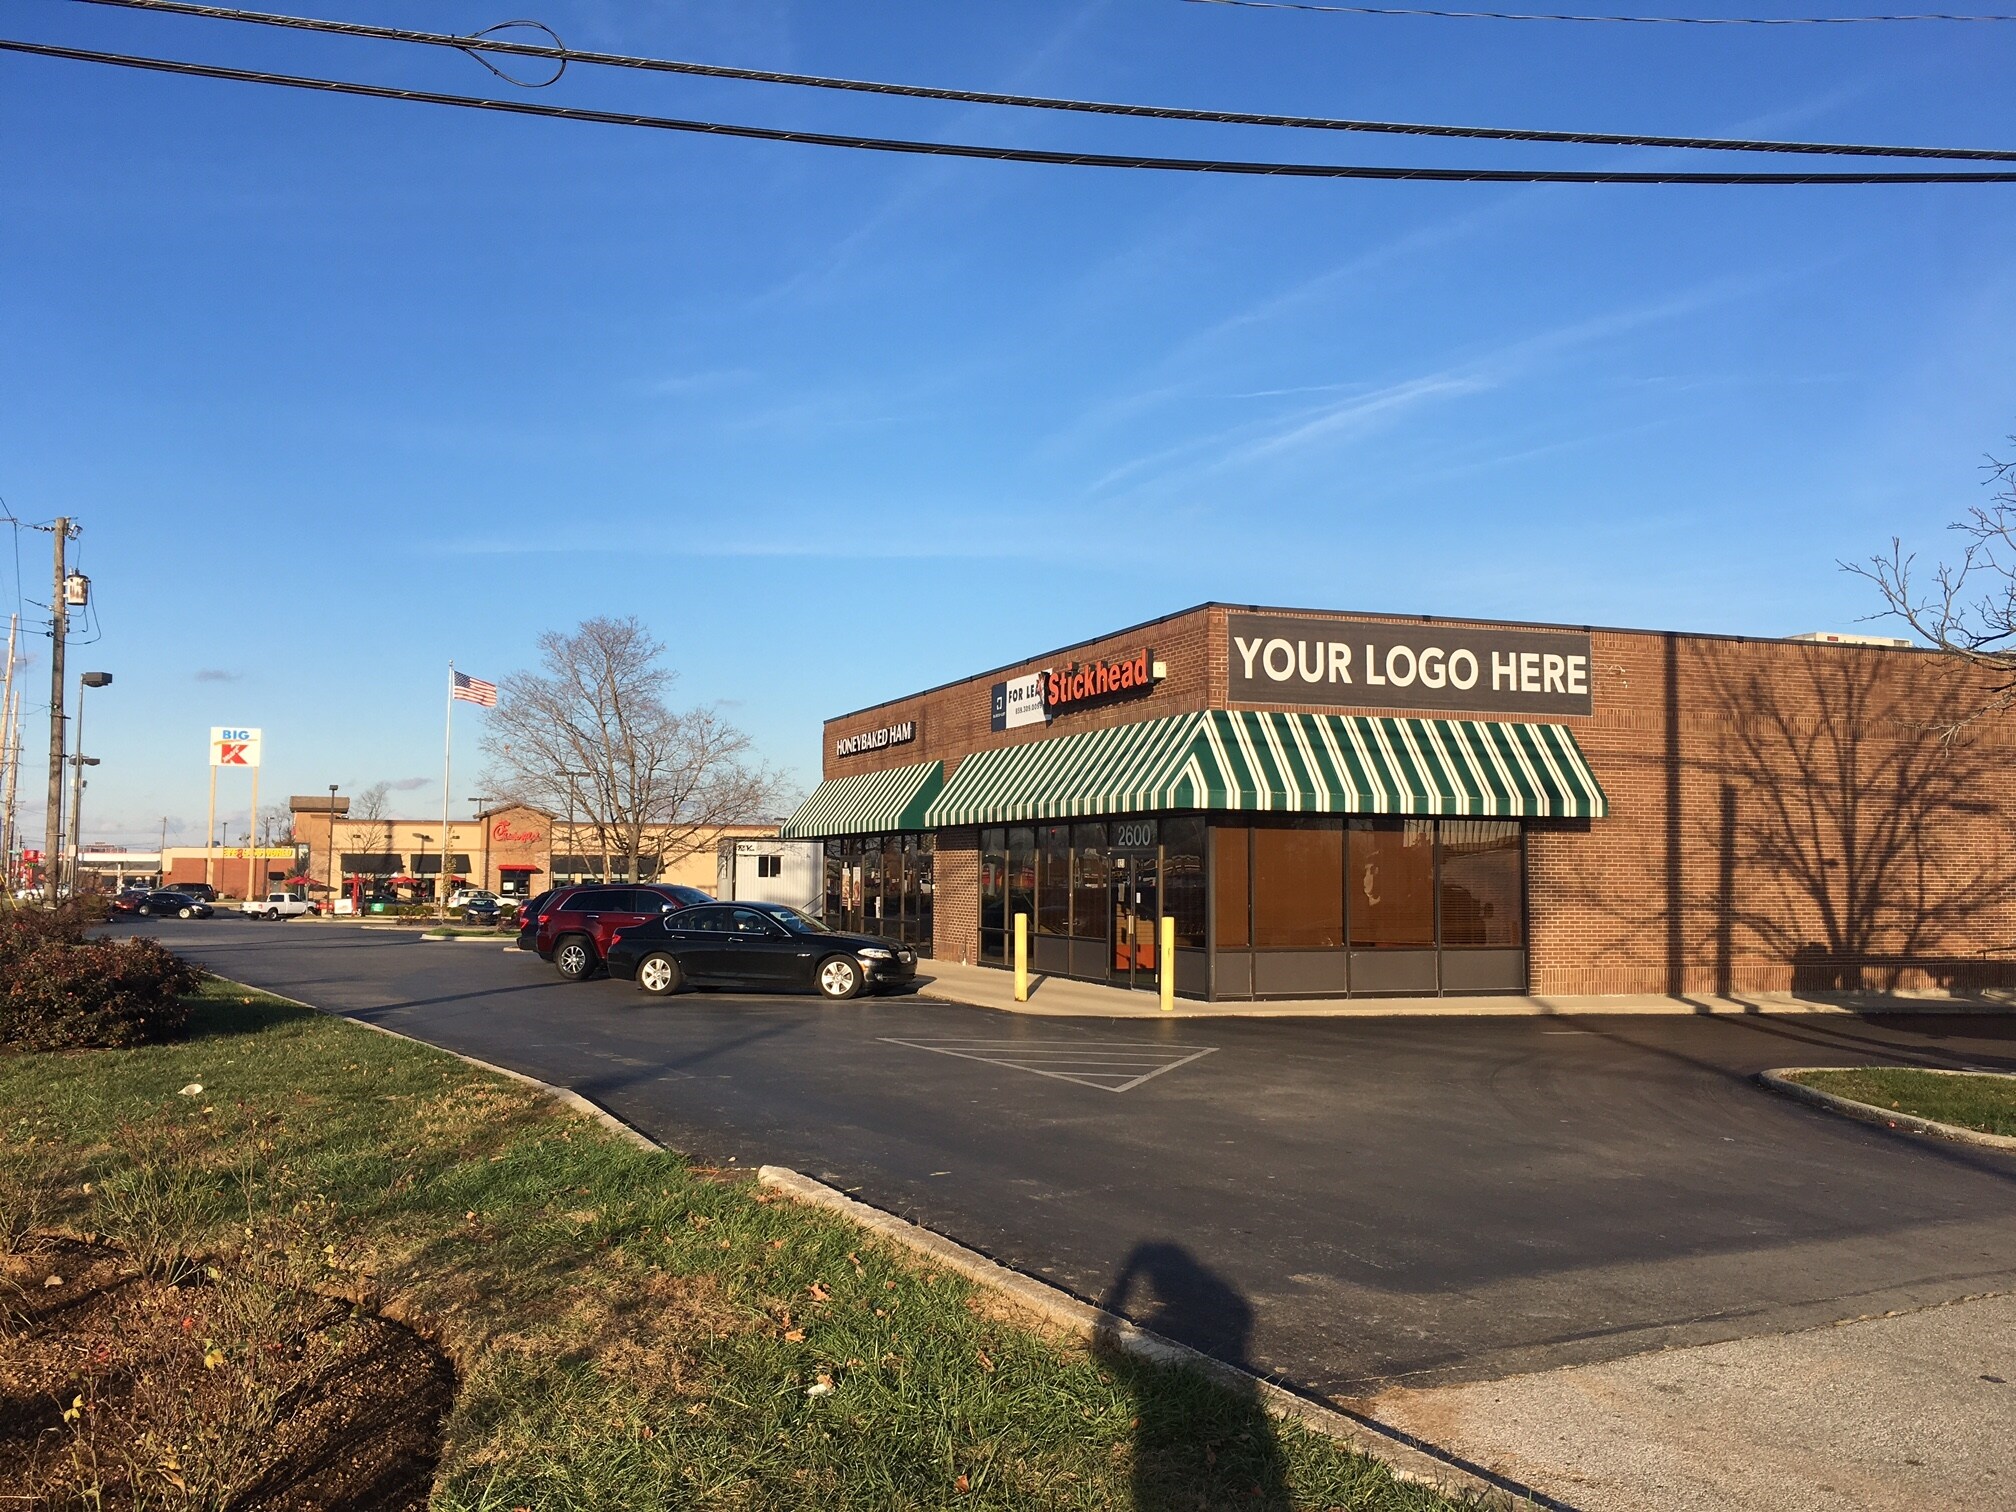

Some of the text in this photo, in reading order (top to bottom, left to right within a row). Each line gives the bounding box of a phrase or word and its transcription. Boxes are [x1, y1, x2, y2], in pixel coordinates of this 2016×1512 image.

[1048, 648, 1149, 705] Stickhead
[1234, 637, 1588, 695] YOUR LOGO HERE
[1008, 687, 1024, 703] FOR
[222, 729, 250, 740] BIG
[889, 721, 912, 743] HAM
[1118, 824, 1151, 846] 2600
